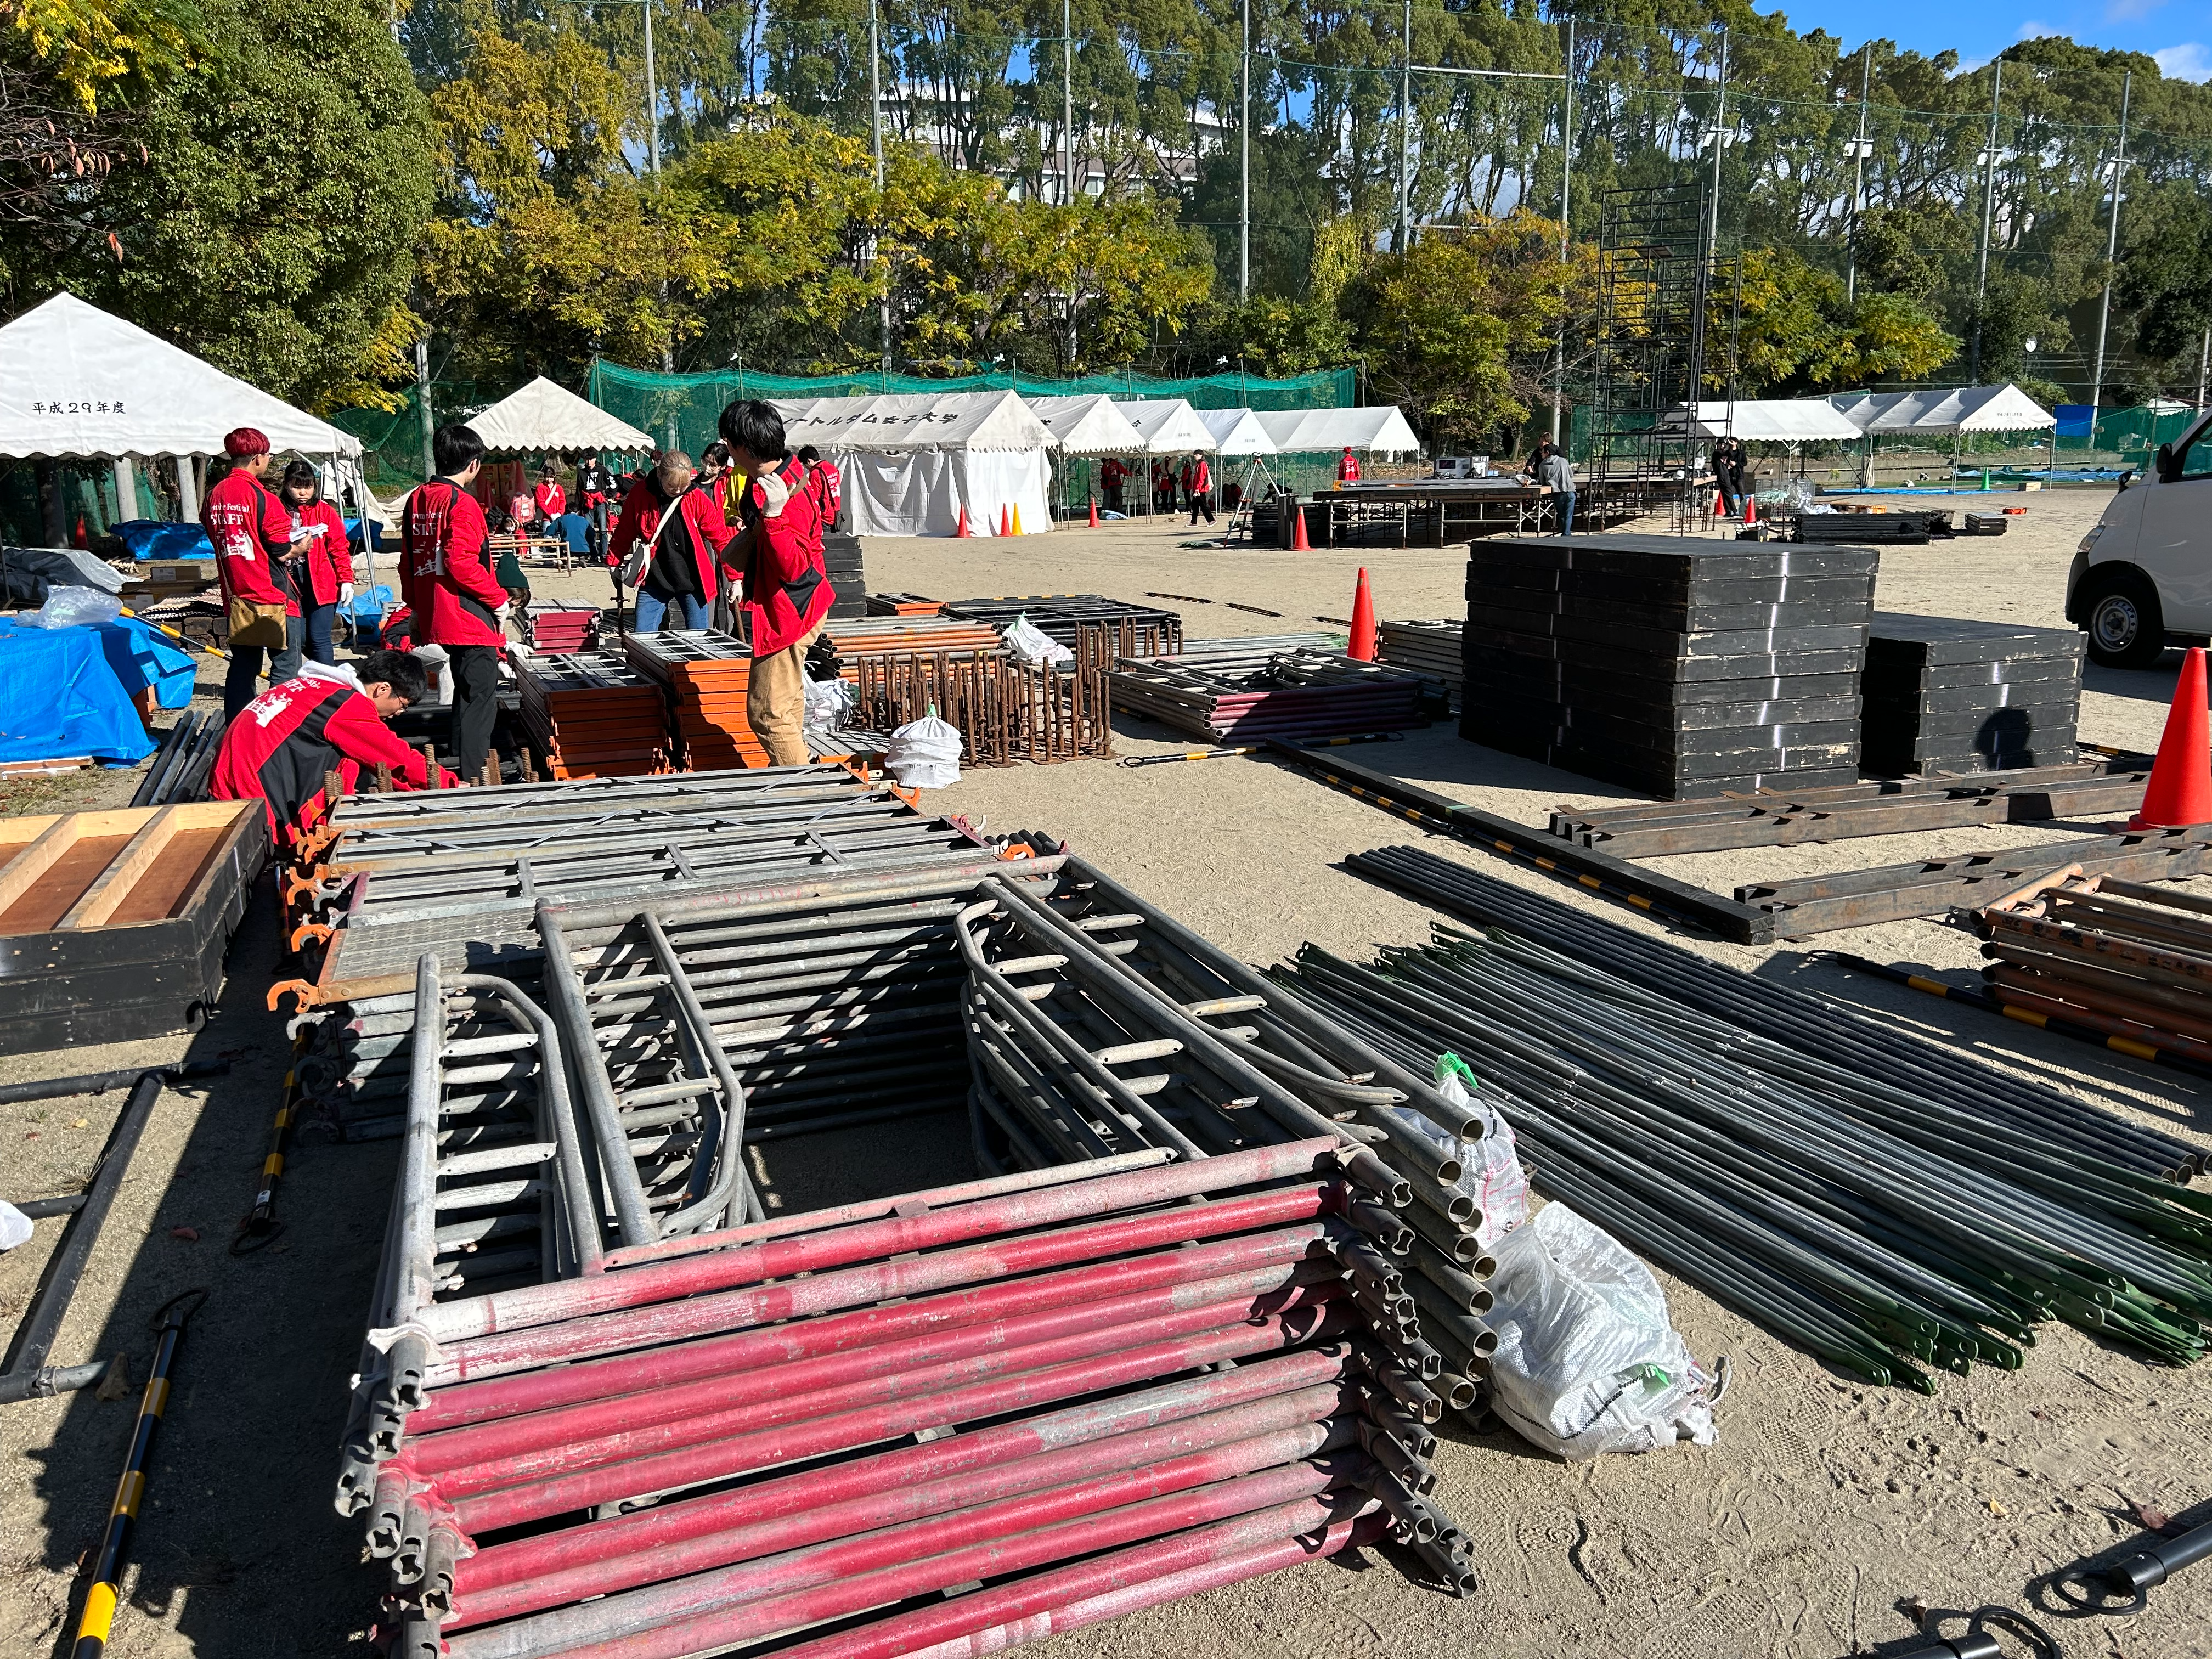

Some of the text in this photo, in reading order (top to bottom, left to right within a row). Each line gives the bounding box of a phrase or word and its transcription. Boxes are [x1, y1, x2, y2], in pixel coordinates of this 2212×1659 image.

[31, 400, 127, 415] 平成29年度
[211, 514, 244, 526] STAFF
